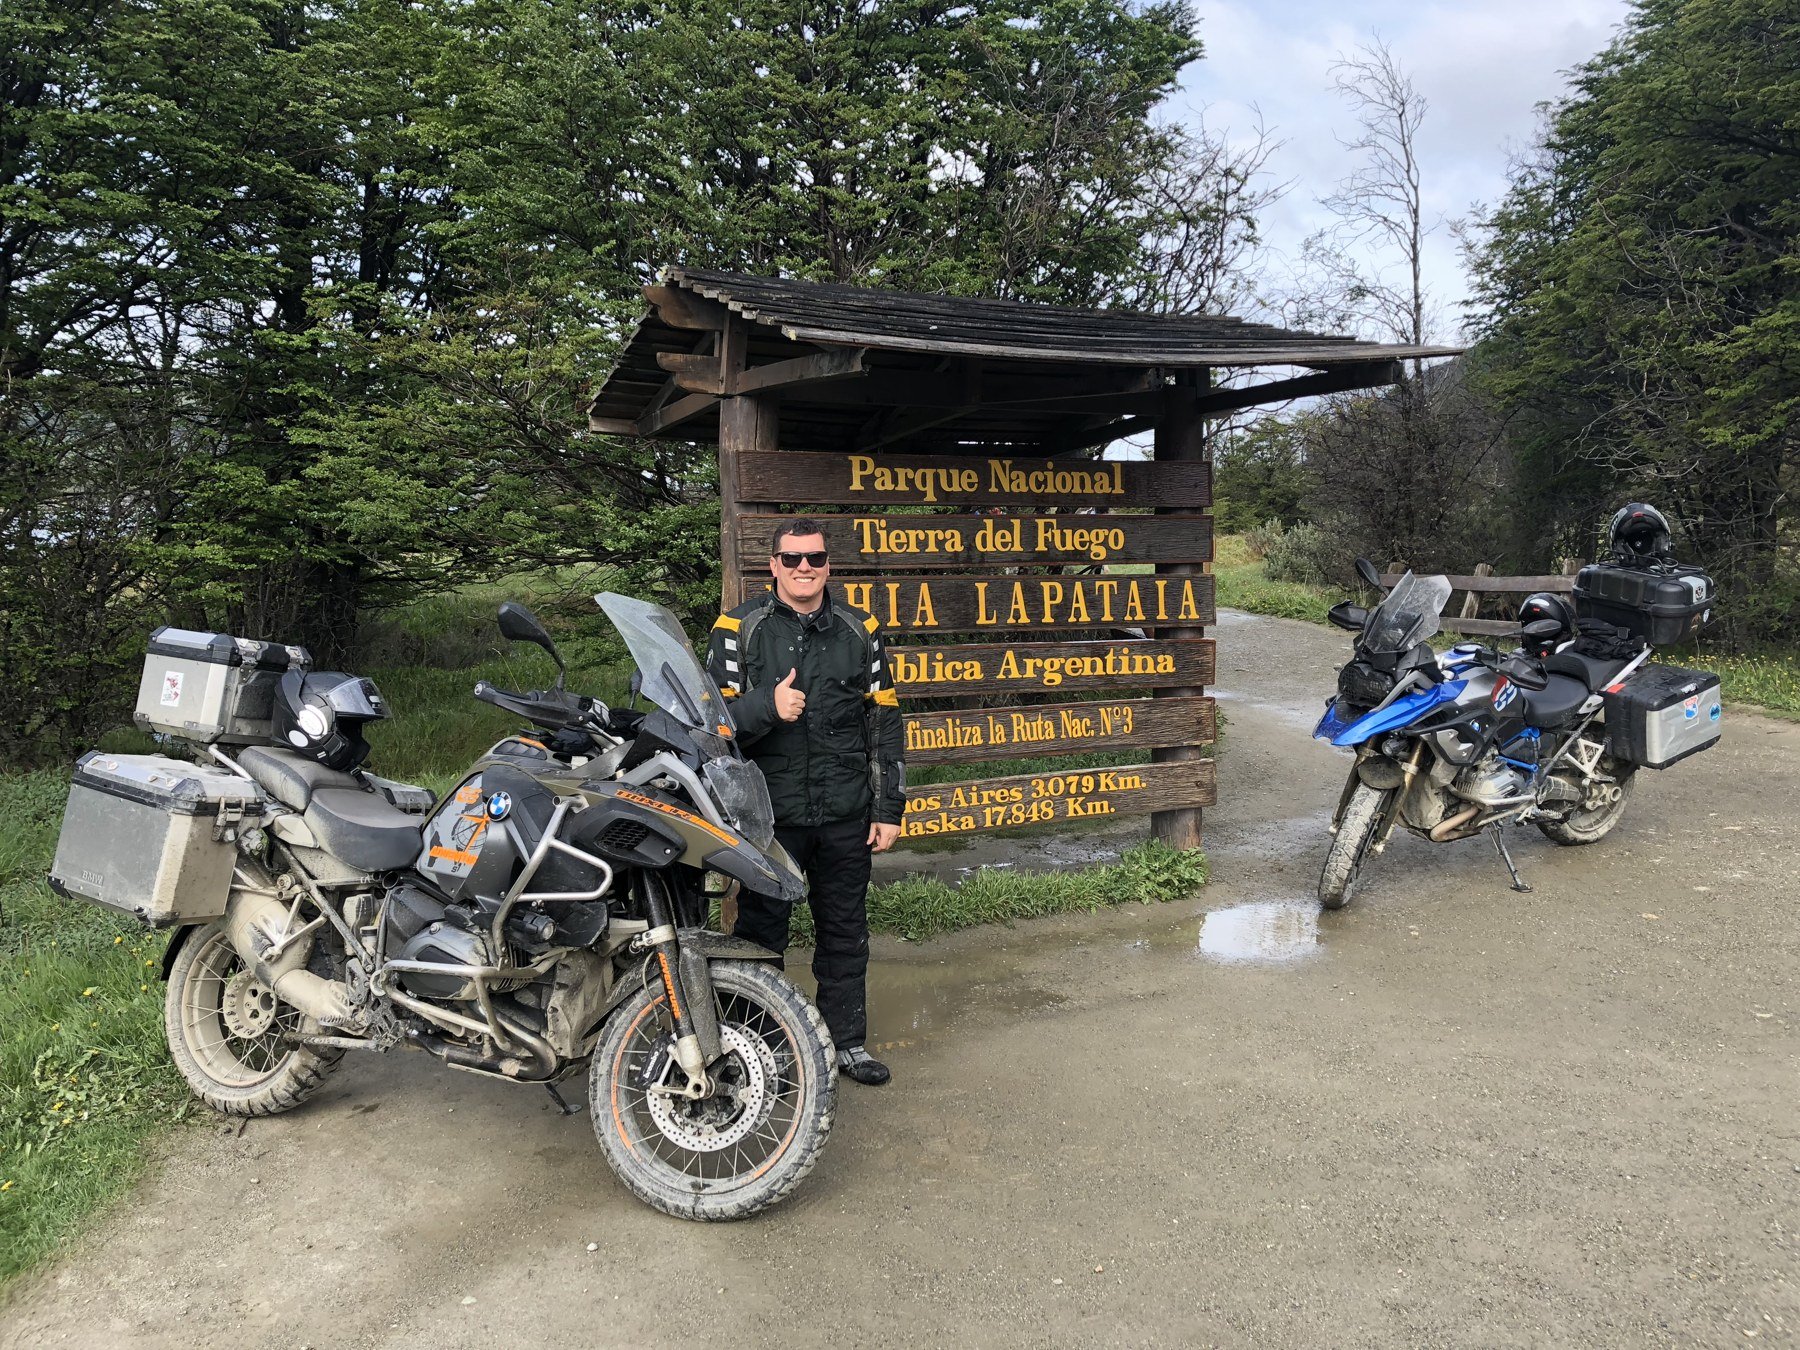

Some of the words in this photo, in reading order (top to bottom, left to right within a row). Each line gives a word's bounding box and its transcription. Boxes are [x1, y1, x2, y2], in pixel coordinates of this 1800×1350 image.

[848, 455, 979, 502] Parque
[988, 459, 1125, 494] Nacional
[853, 518, 965, 554] Tierra
[974, 518, 1024, 553] del
[1035, 518, 1125, 561] Fuego
[975, 579, 1200, 626] LAPATAIA
[997, 648, 1176, 686] Argentina
[906, 717, 984, 751] finaliza
[987, 715, 1007, 745] la
[1010, 712, 1056, 744] Ruta
[1059, 709, 1096, 740] Nac.
[948, 785, 1024, 809] Aires
[1030, 774, 1096, 800] 3.079
[1097, 771, 1149, 794] Km.
[981, 799, 1056, 828] 17.848
[1065, 796, 1117, 818] Km.
